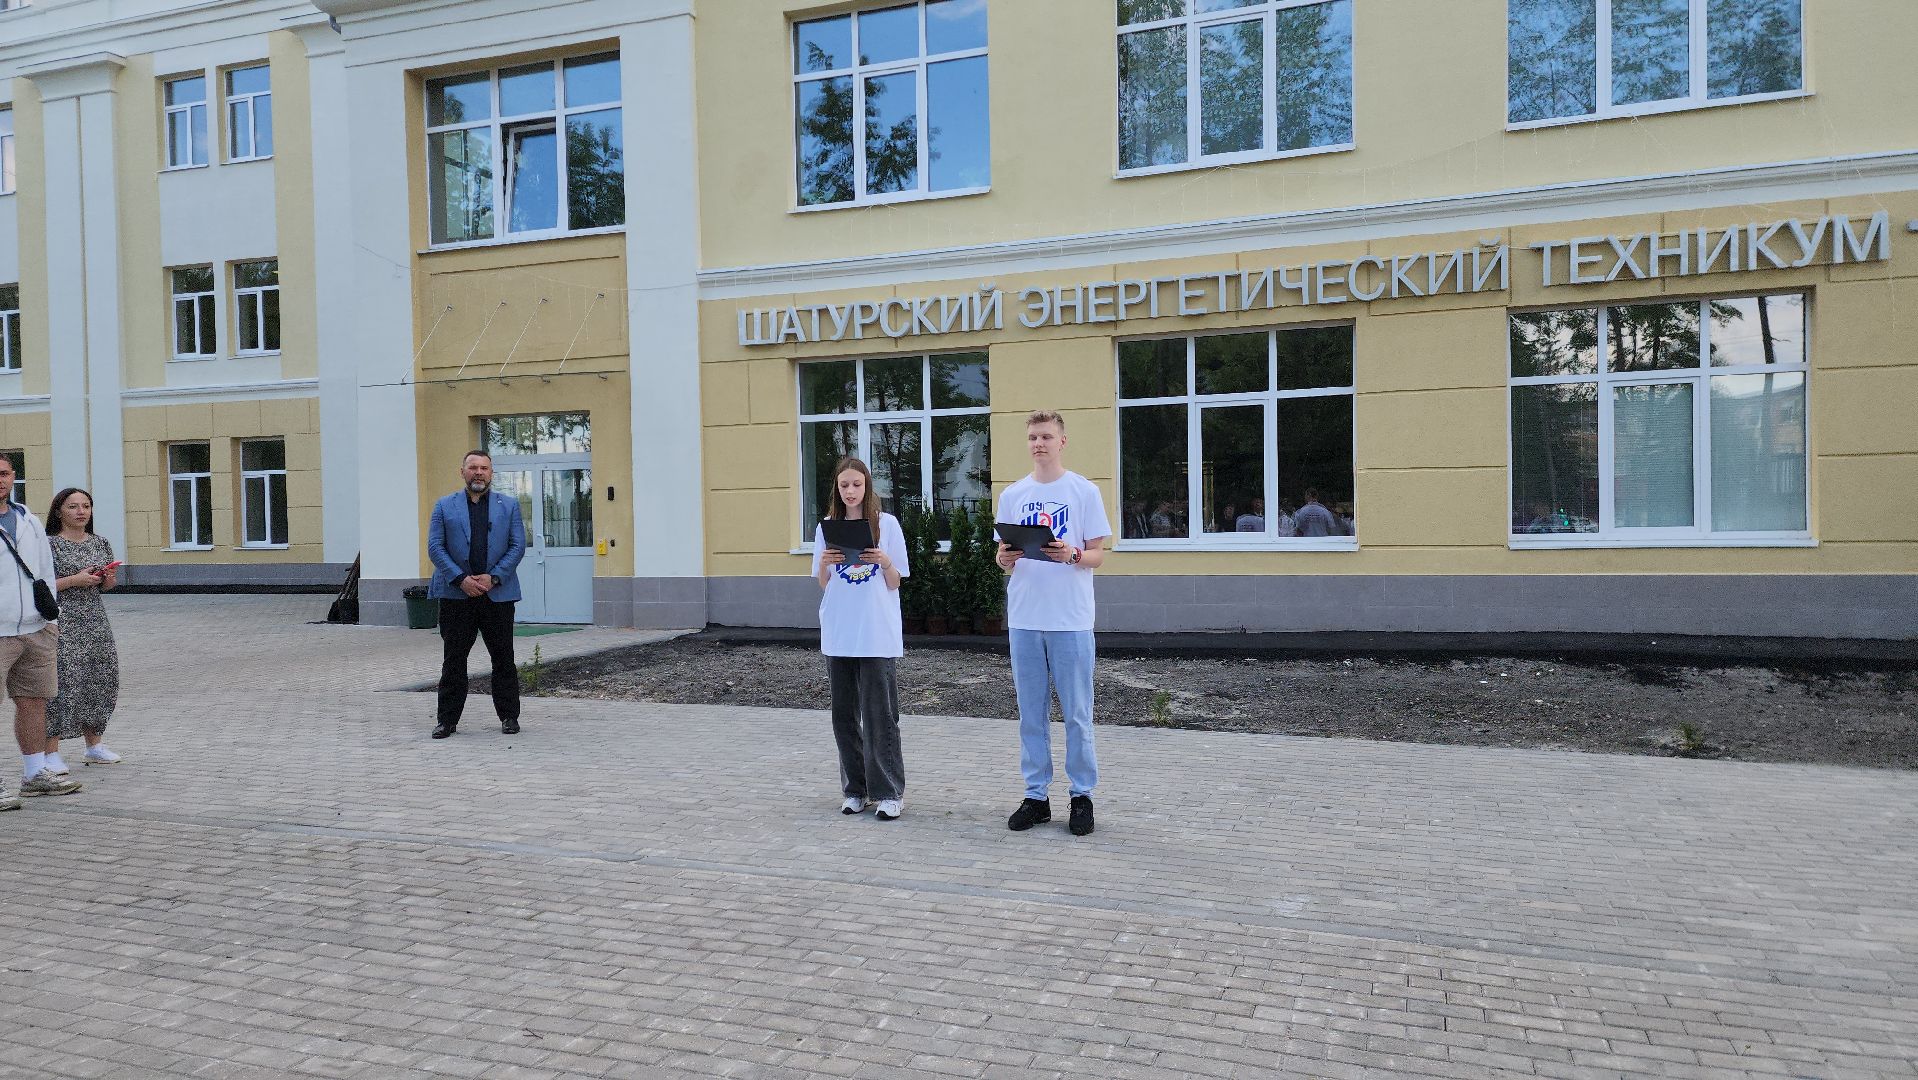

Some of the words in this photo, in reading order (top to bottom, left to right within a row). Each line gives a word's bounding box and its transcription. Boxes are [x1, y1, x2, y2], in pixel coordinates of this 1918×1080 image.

[738, 284, 1003, 346] ШАТУРСКИЙ
[1018, 237, 1509, 328] ЭНЕРГЕТИЧЕСКИЙ
[1530, 210, 1889, 286] ТЕХНИКУМ
